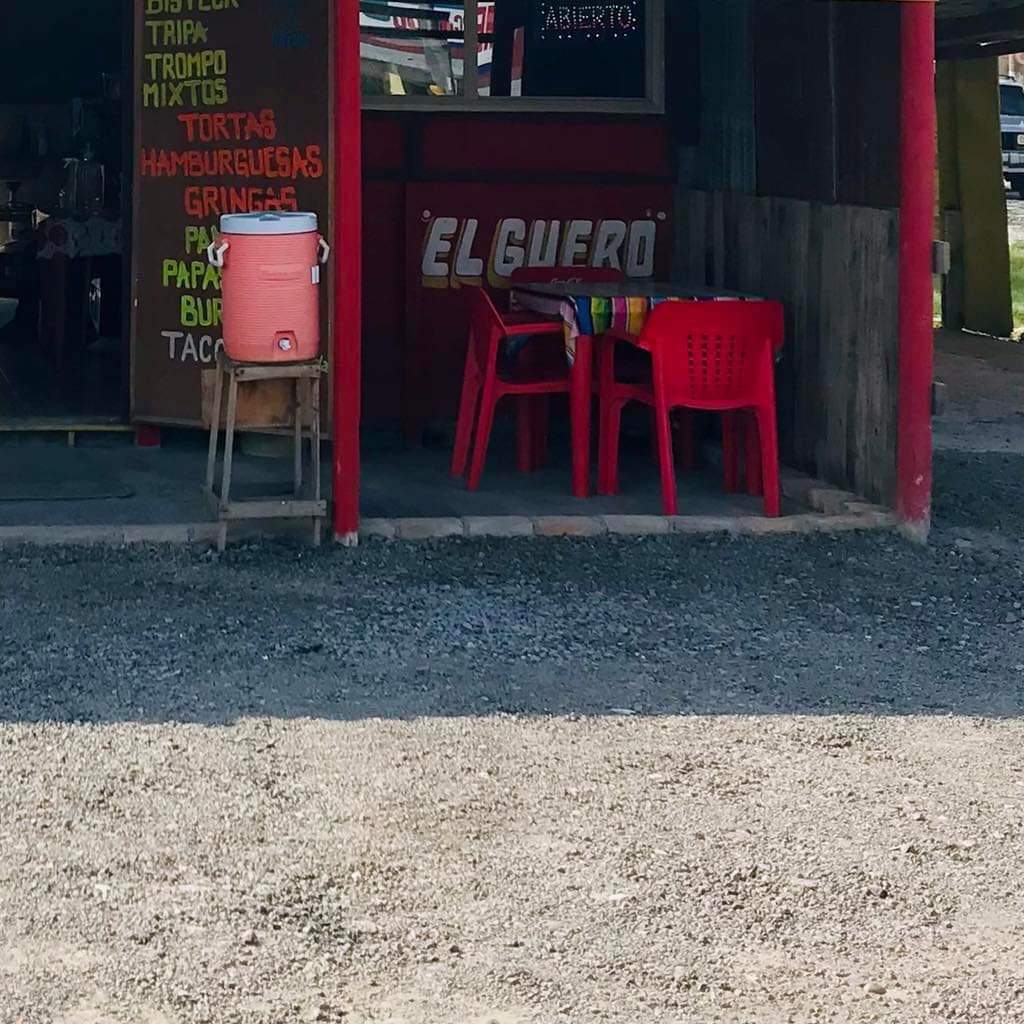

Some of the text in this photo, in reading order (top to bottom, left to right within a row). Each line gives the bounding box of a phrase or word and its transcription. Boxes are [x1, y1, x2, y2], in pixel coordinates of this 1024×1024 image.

[145, 19, 208, 46] TRIPA
[546, 5, 632, 30] ABIERTO
[145, 49, 227, 80] TROMPO
[143, 78, 228, 107] MIXTOS
[178, 109, 276, 143] TORTAS
[140, 145, 323, 178] HAMBURGUESAS
[184, 186, 298, 219] GRINGAS
[422, 216, 657, 288] EL GUERO
[162, 259, 223, 290] PAPA
